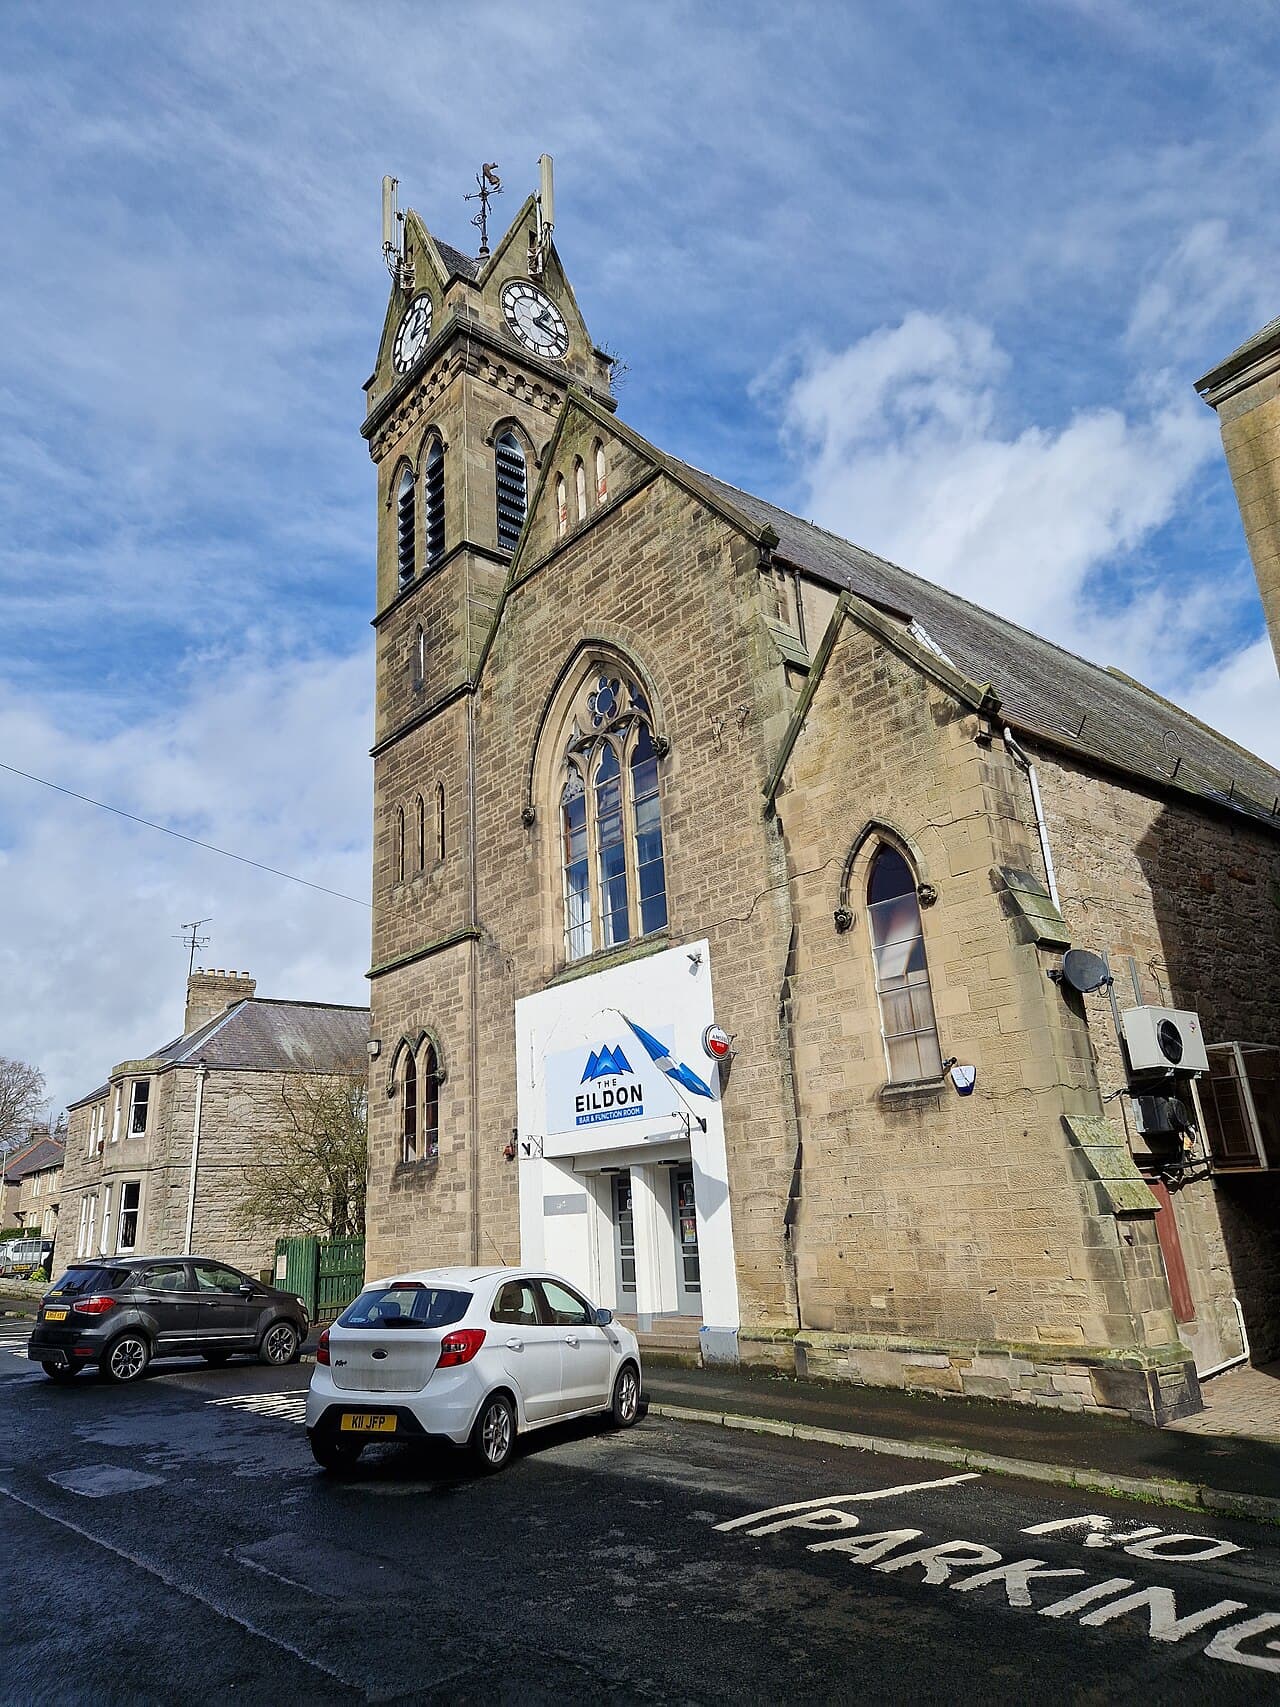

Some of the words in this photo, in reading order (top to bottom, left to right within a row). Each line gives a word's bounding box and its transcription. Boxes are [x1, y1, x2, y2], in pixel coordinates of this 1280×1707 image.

[597, 1078, 617, 1089] THE
[575, 1083, 643, 1113] EILDON
[578, 1115, 590, 1124] BAR
[595, 1110, 623, 1121] FUNCTION
[623, 1107, 640, 1117] ROOM
[365, 1415, 386, 1429] JFP
